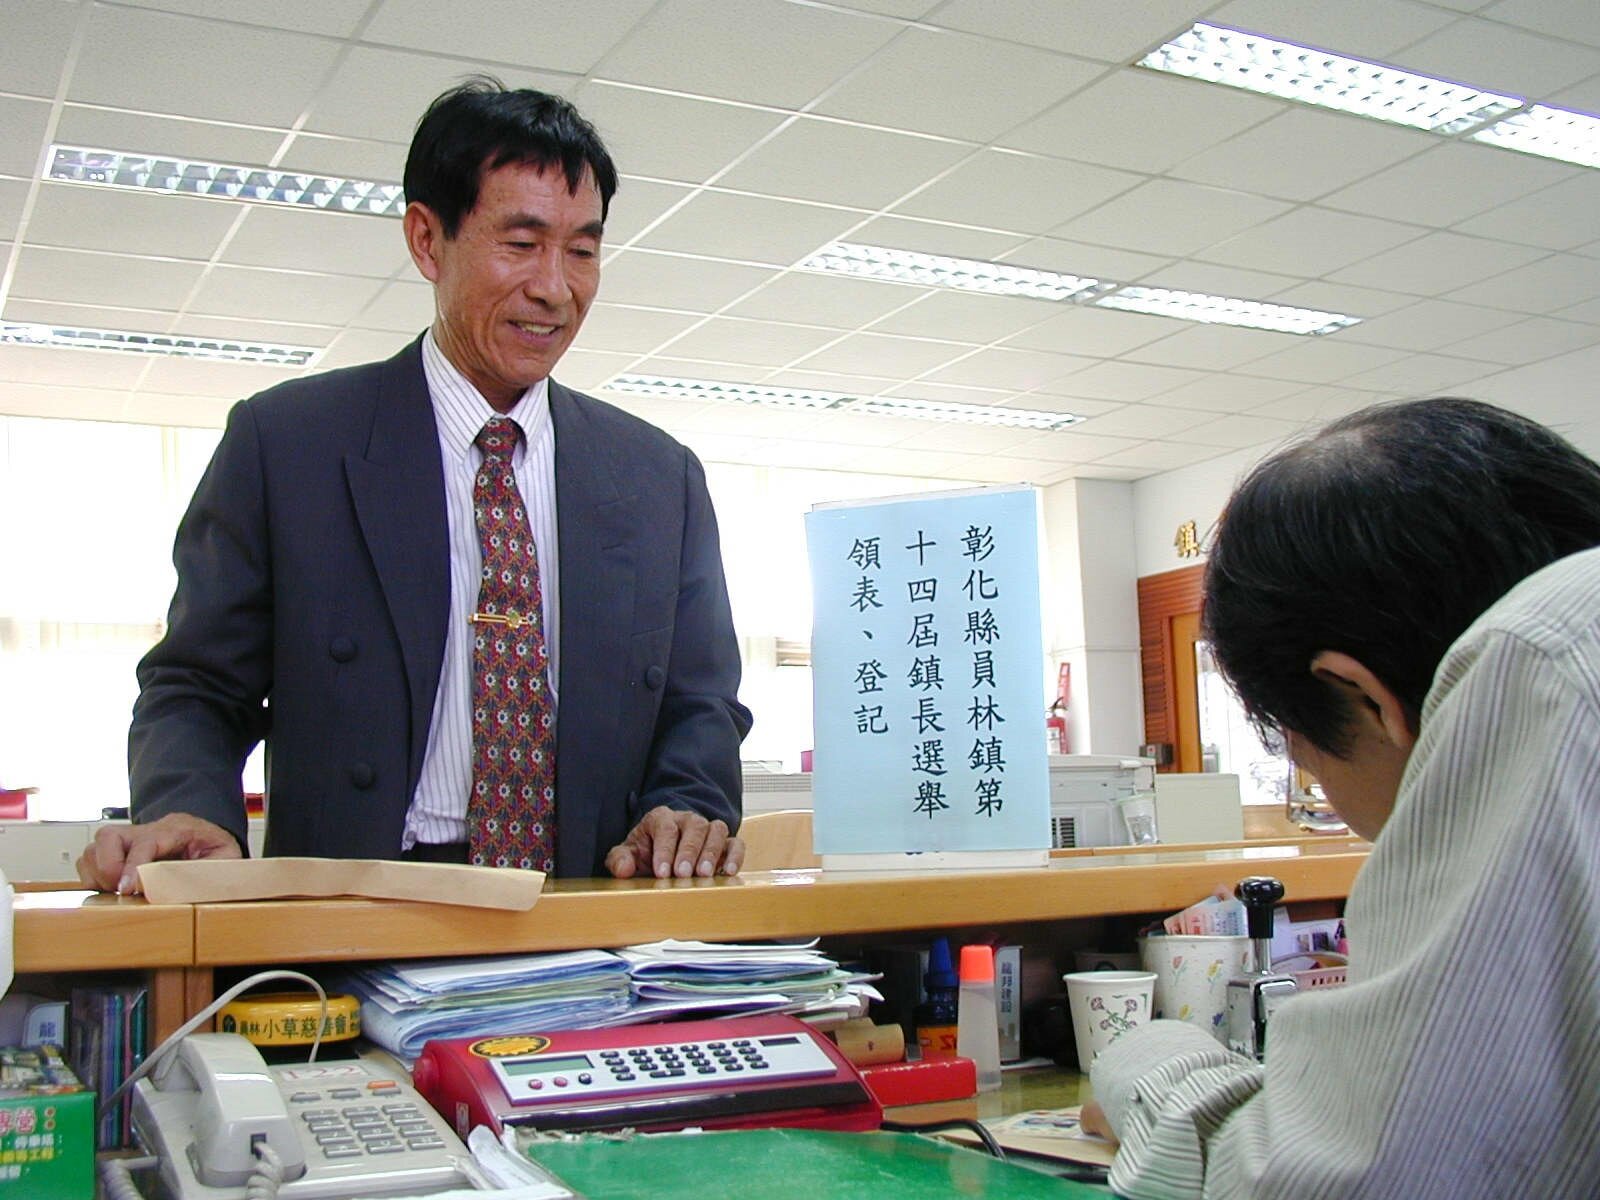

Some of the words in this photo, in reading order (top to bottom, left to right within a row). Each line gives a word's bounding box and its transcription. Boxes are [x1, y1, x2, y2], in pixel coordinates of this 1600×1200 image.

[847, 536, 889, 735] 領表、登記
[905, 530, 950, 819] 十四屆鎮長選舉
[960, 524, 1007, 818] 彰化縣員林鎮第
